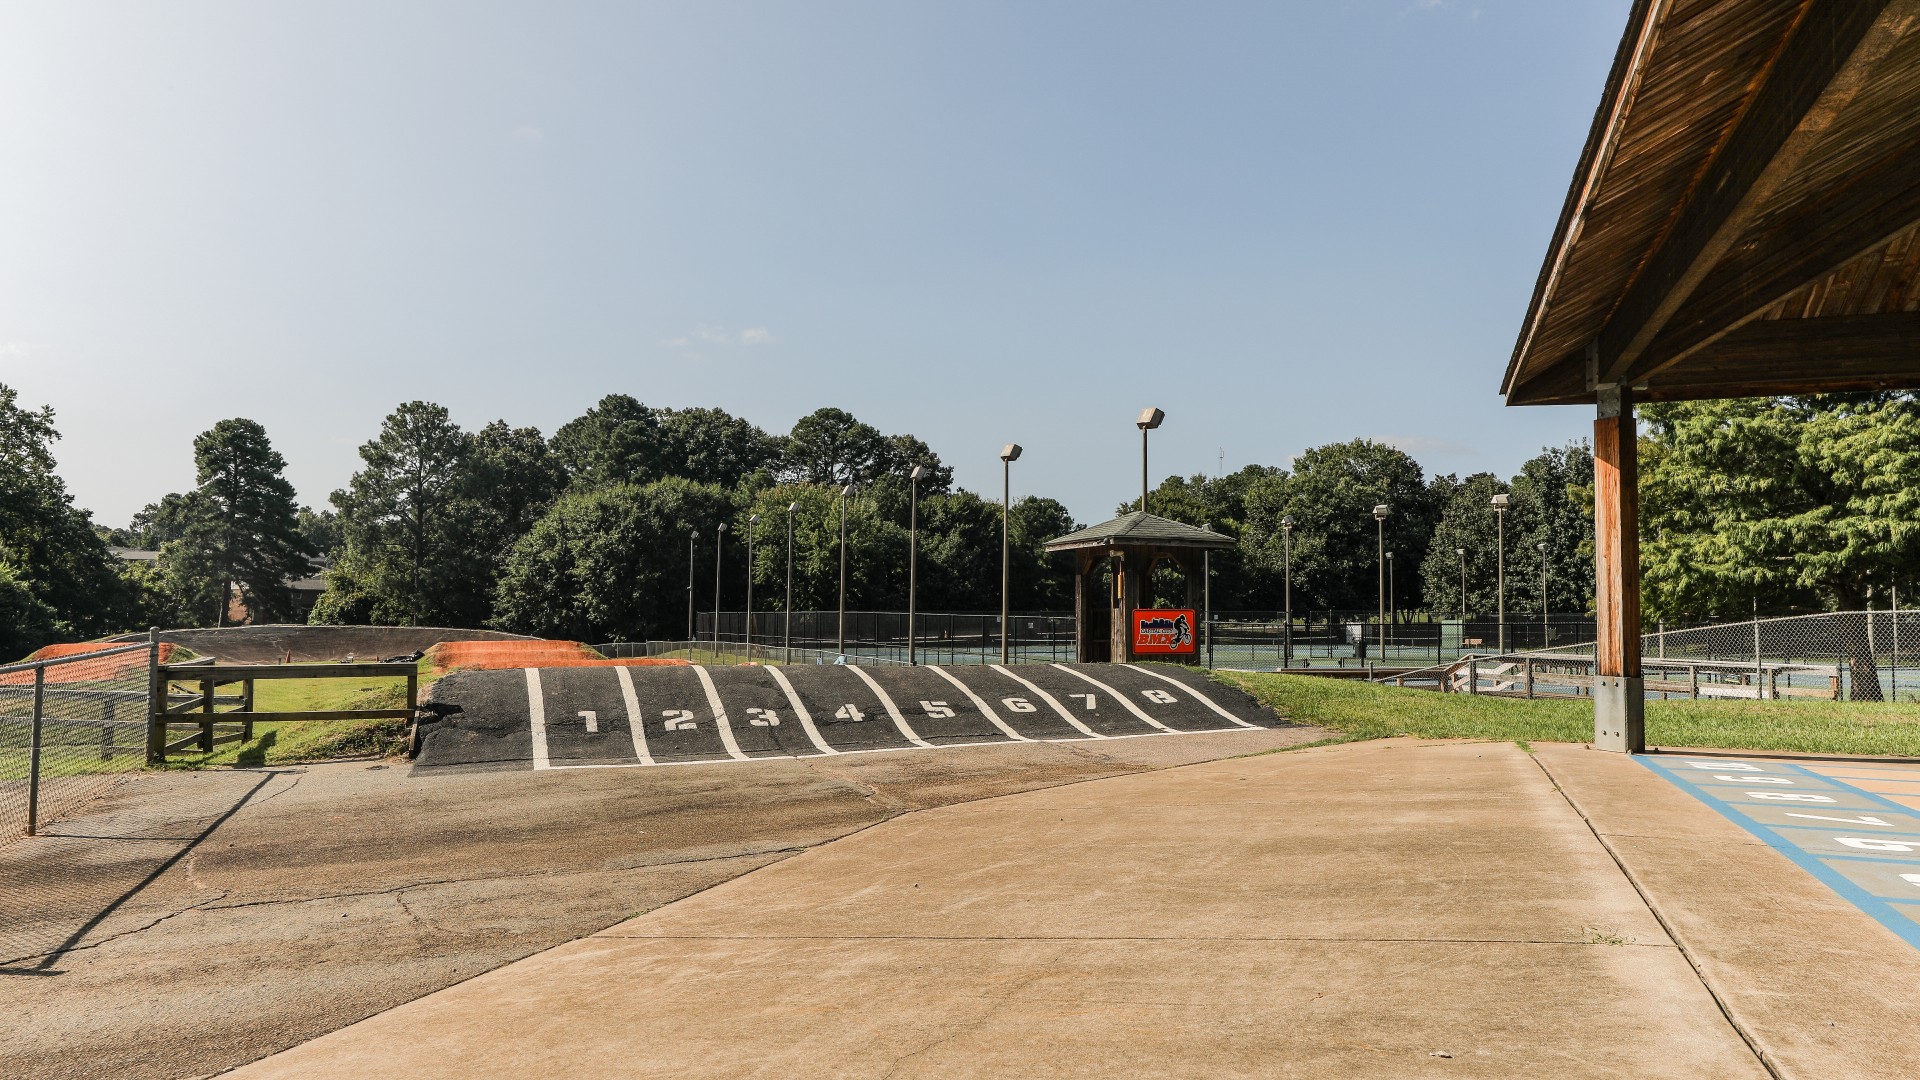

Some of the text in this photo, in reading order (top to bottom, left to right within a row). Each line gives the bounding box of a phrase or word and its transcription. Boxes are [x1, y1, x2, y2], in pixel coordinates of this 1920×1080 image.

[1137, 633, 1174, 645] BMX
[577, 689, 1178, 732] 1 2 3 4 5 6 7 8
[1744, 791, 1838, 803] 8
